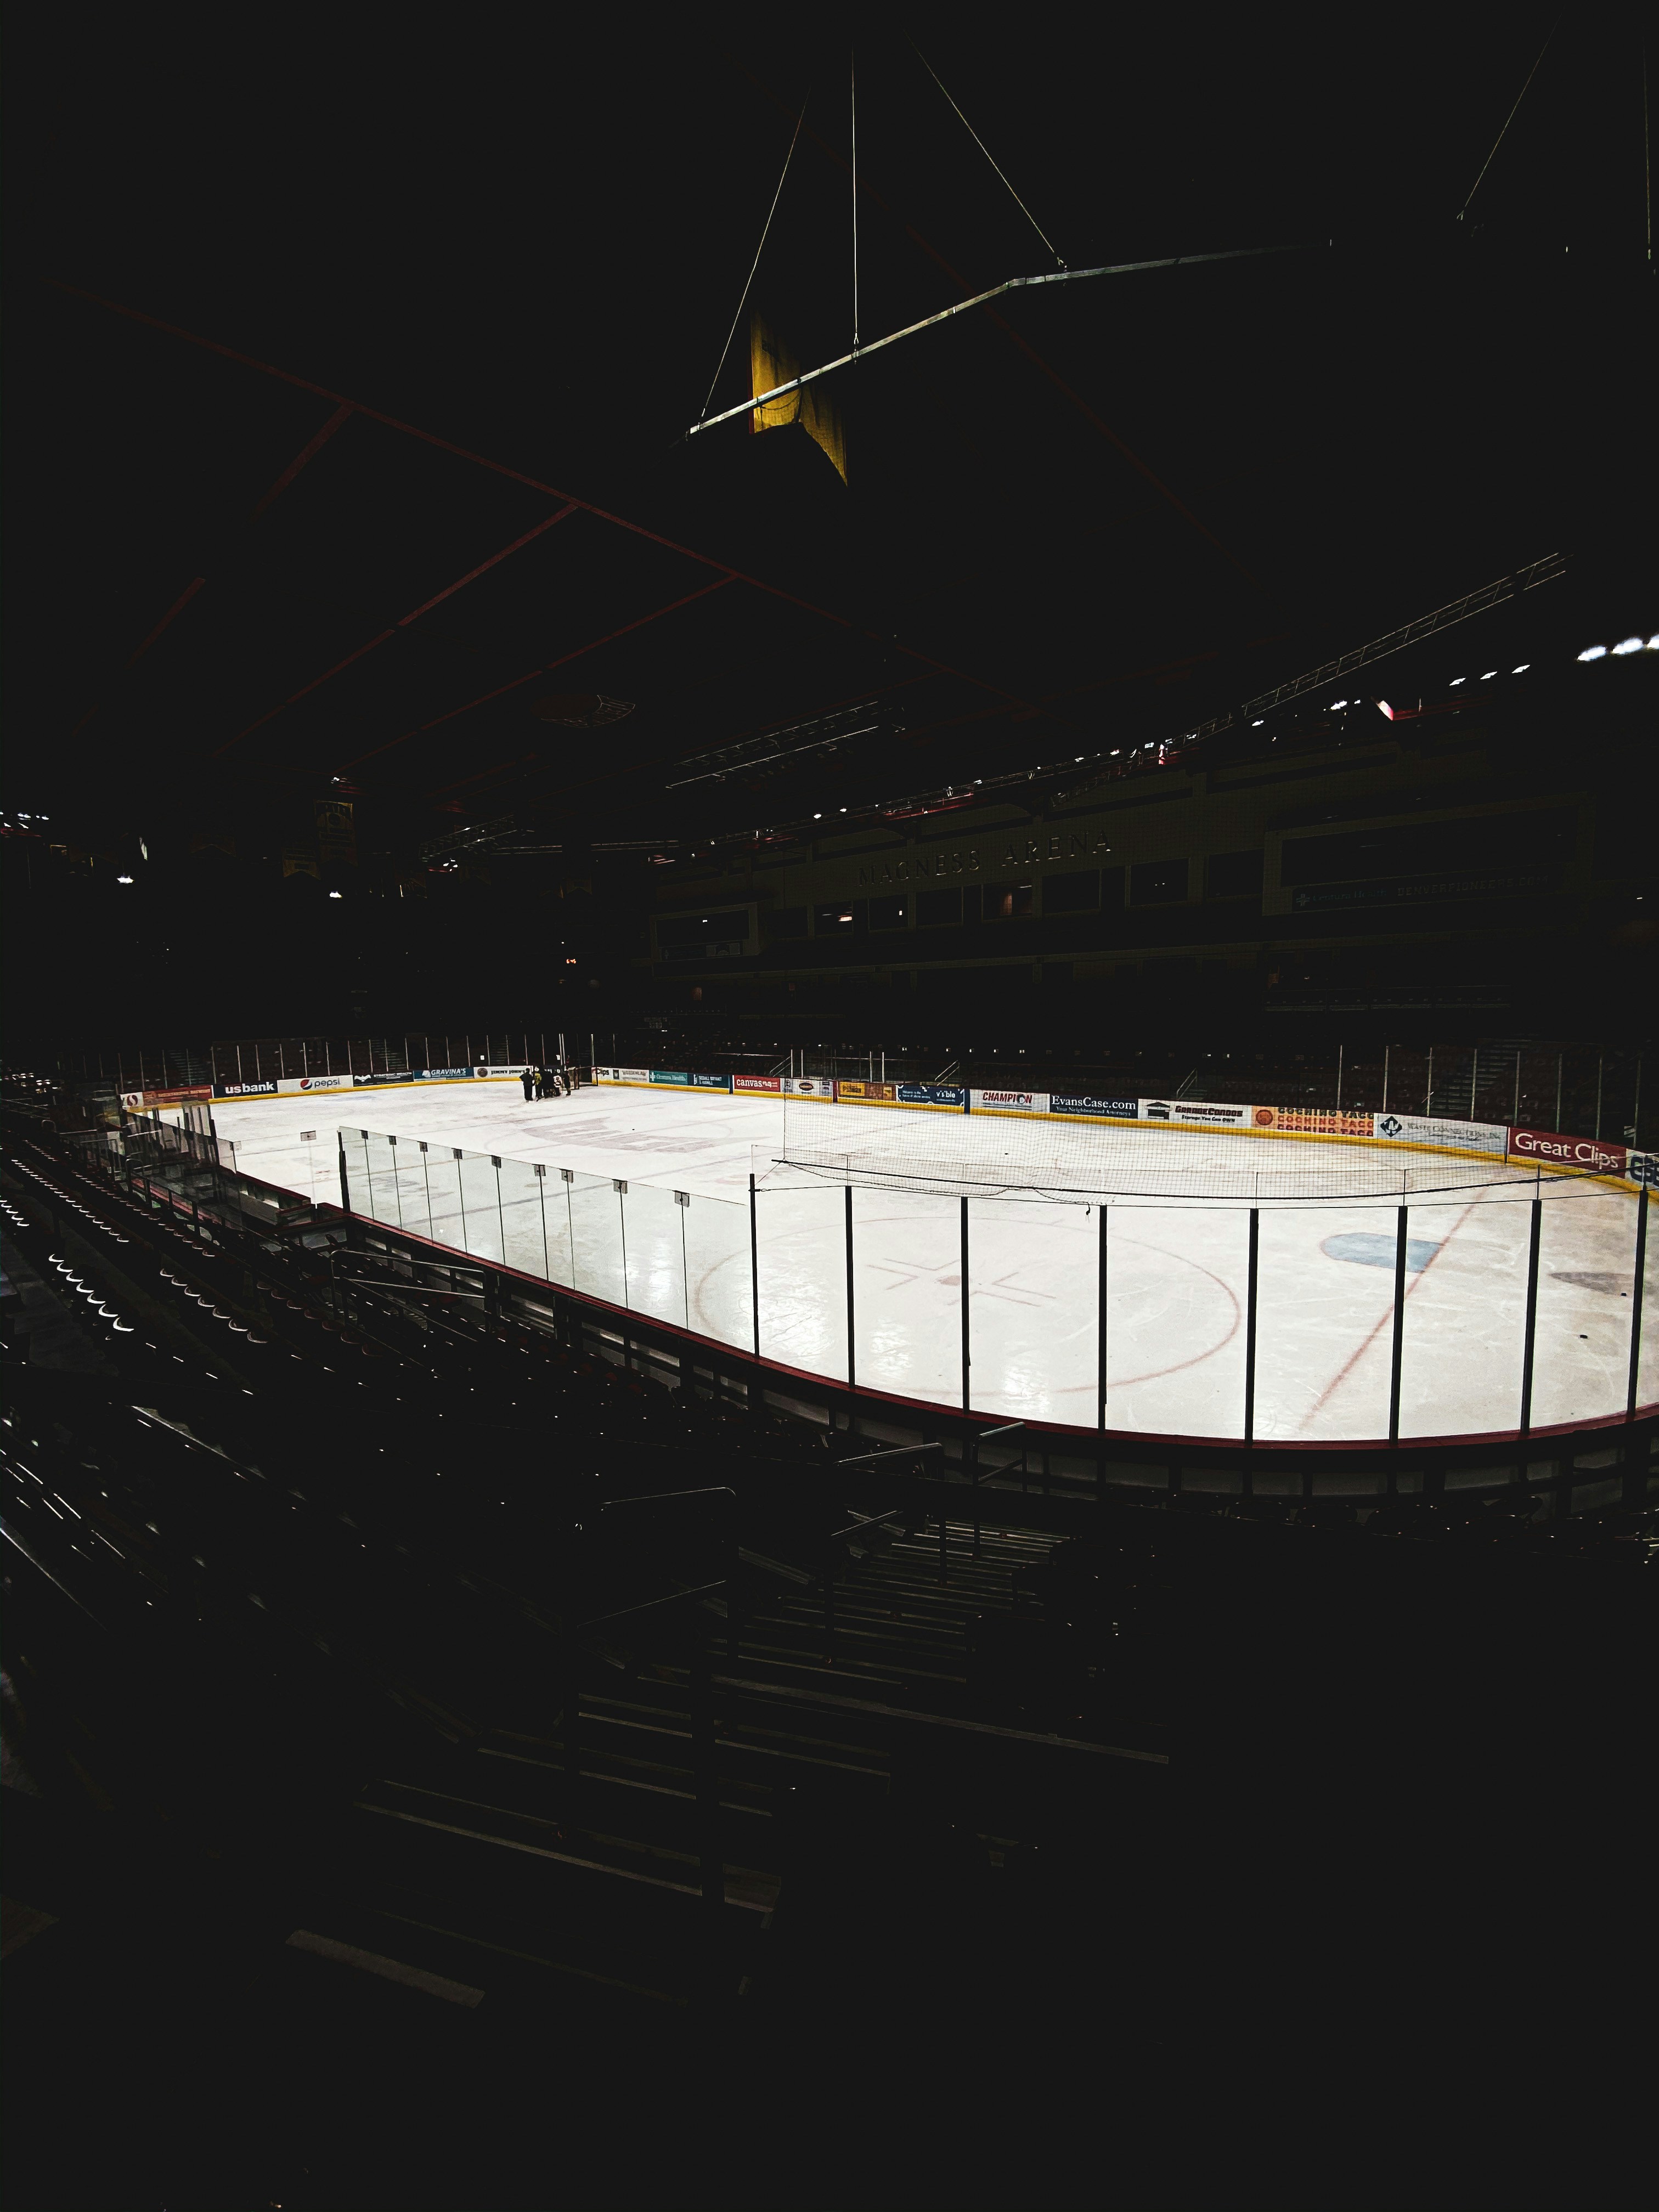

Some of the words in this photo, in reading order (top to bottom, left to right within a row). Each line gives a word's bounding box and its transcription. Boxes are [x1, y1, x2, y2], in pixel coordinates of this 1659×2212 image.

[858, 849, 980, 887] MAGNESS
[1000, 830, 1112, 867] ARENA
[314, 1077, 340, 1088] pepsi
[736, 1079, 763, 1087] canvas
[983, 1092, 1032, 1104] CHAMPION
[1051, 1095, 1137, 1109] EvansCase.com
[1278, 1107, 1337, 1117] COCHINO
[1341, 1110, 1374, 1119] TACO
[1278, 1115, 1336, 1125] COCHINO
[1341, 1119, 1374, 1128] TACO
[1340, 1128, 1374, 1137] TACO
[1515, 1132, 1571, 1158] Great
[1575, 1143, 1619, 1170] Clips
